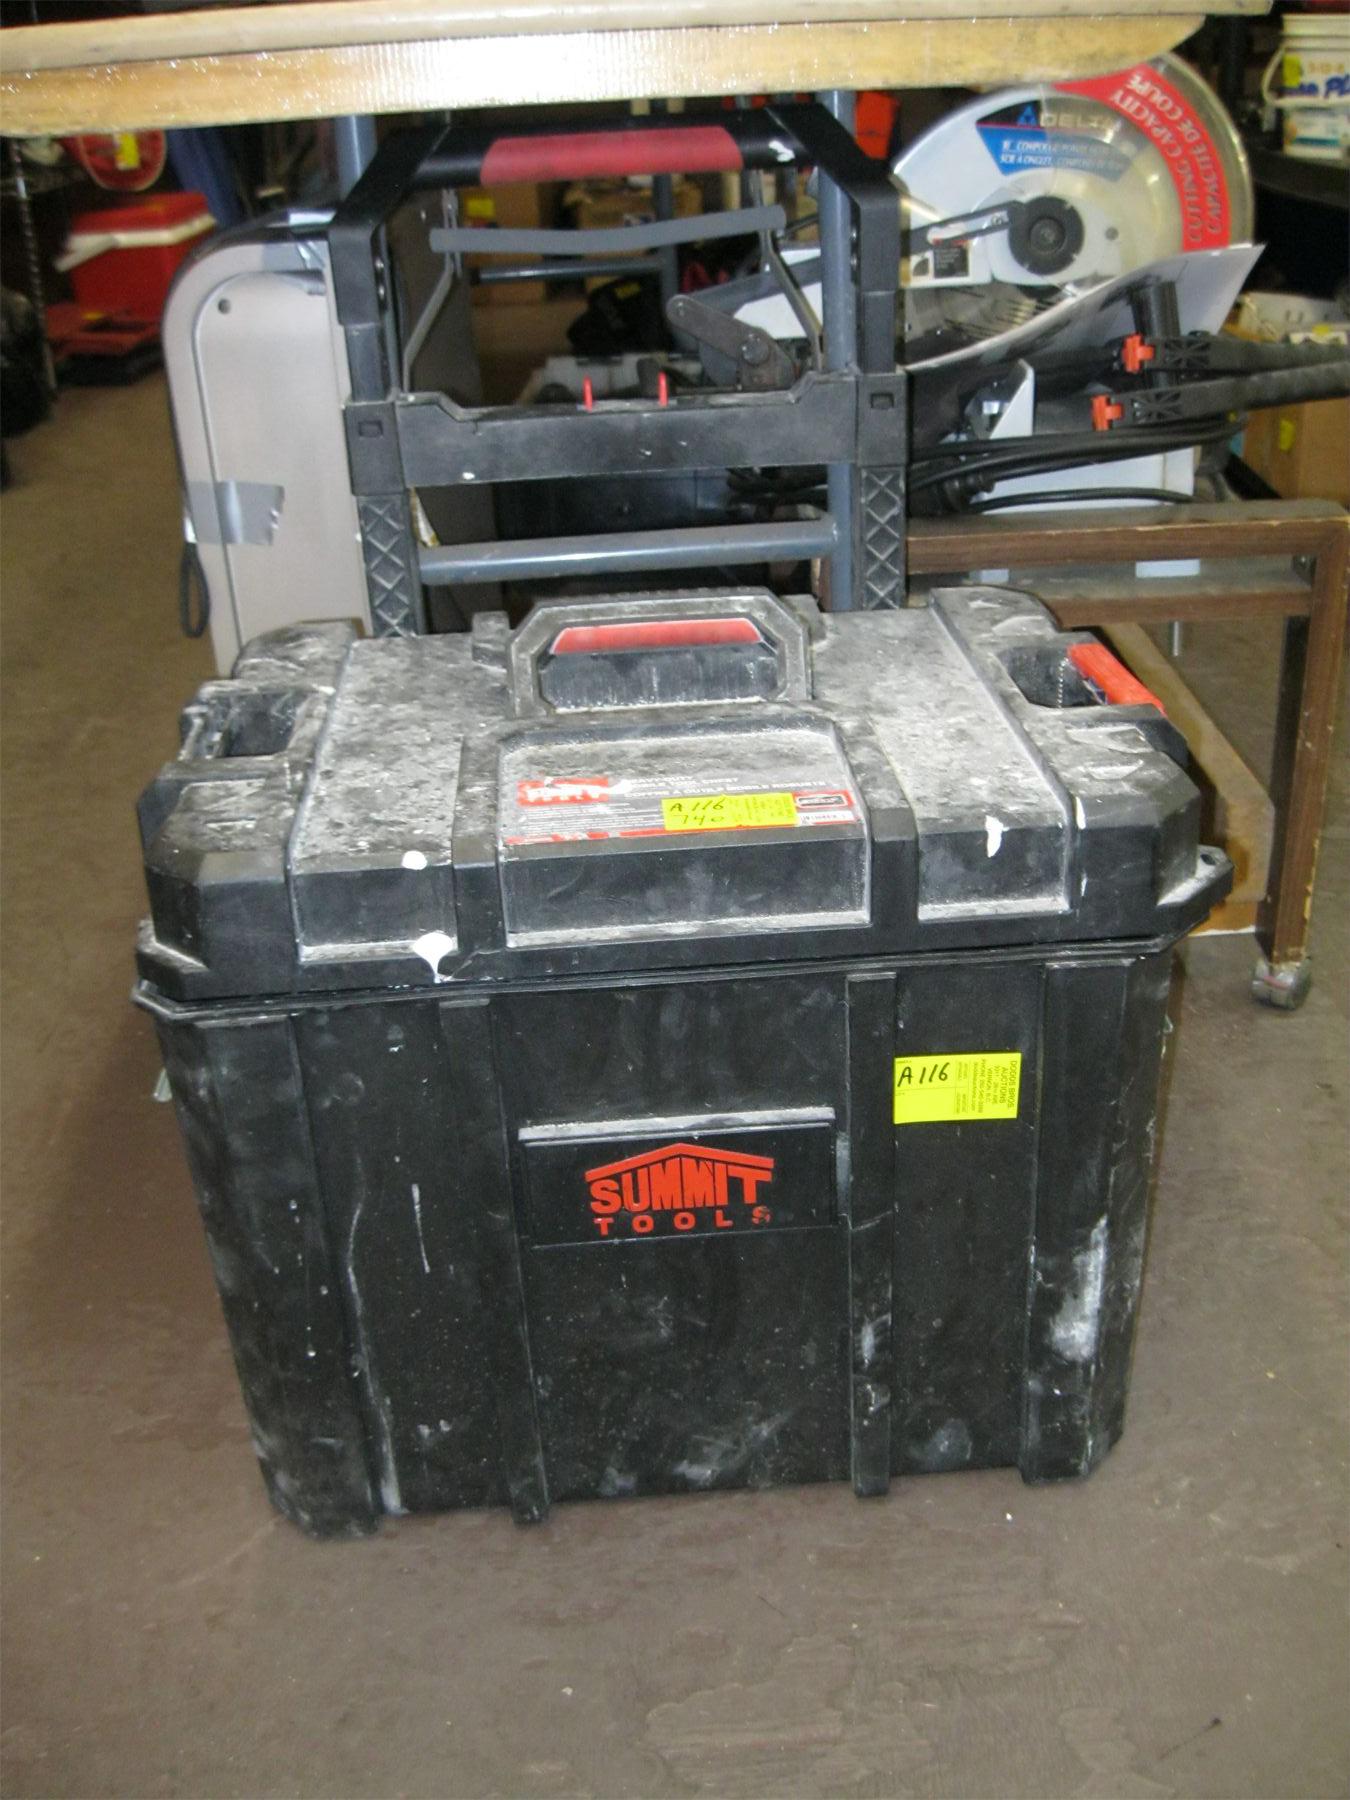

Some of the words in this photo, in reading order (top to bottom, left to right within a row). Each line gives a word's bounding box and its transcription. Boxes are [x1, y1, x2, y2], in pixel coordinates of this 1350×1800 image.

[1125, 73, 1184, 120] COUPE
[1109, 89, 1182, 157] CAPACITY
[1178, 119, 1201, 143] DE
[1175, 159, 1203, 242] CUTTING
[630, 775, 693, 784] EAVY-DUTY
[670, 797, 726, 812] A116
[897, 1062, 950, 1087] A116
[999, 1067, 1009, 1104] AUCTIONS
[588, 1156, 773, 1214] SUMMIT
[593, 1204, 773, 1236] TOOLS
